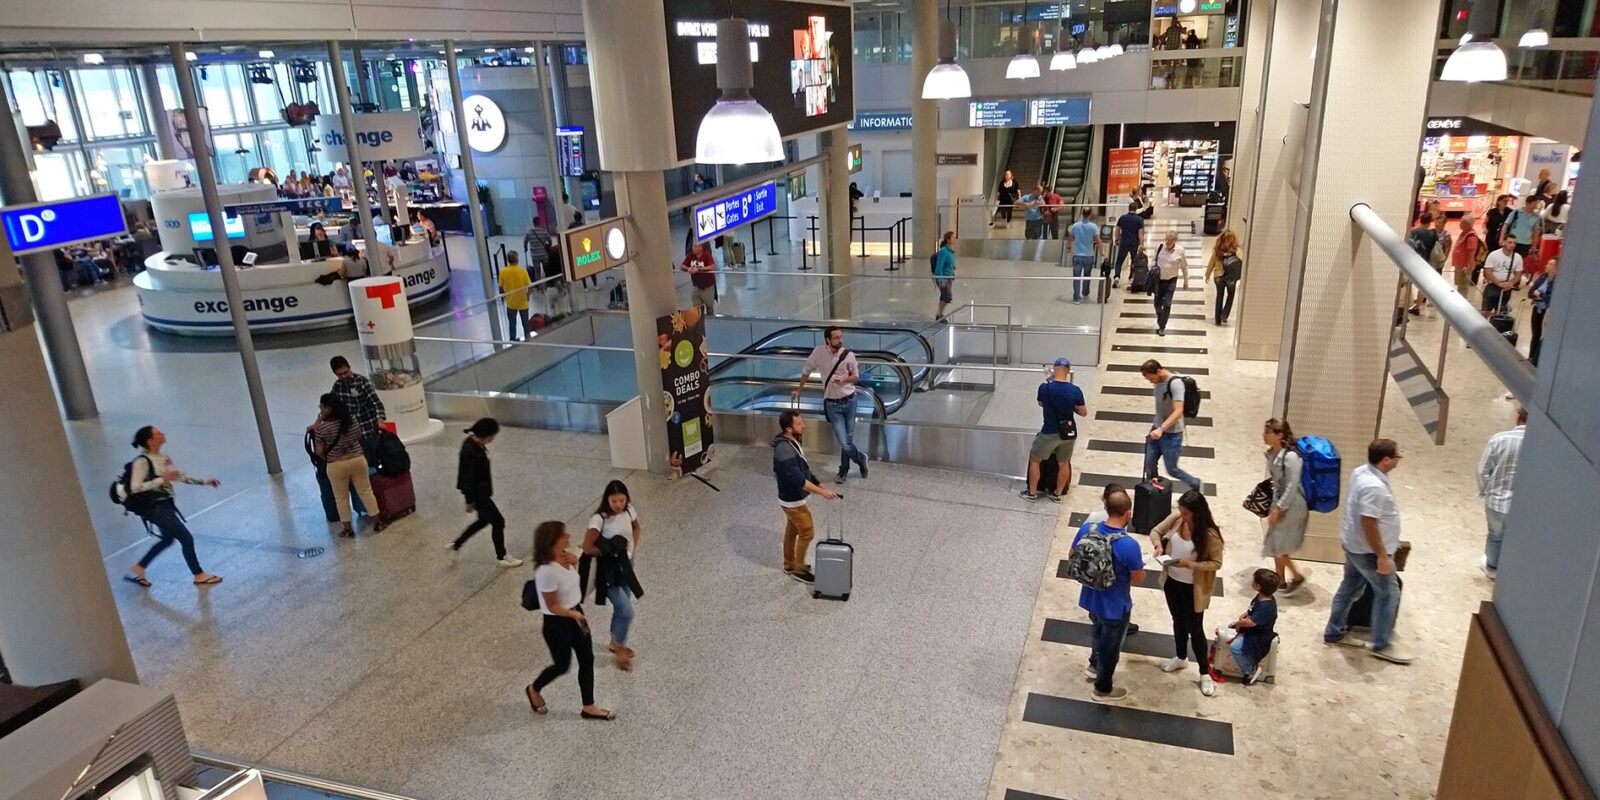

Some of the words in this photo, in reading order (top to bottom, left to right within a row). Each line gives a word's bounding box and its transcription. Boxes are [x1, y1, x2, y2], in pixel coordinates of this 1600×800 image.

[756, 188, 768, 201] Sortie
[725, 200, 740, 212] Portes
[727, 213, 739, 225] Gates
[576, 250, 601, 267] ROLEX
[194, 295, 299, 313] excange
[673, 370, 700, 388] COMBO
[676, 380, 700, 396] DEALS
